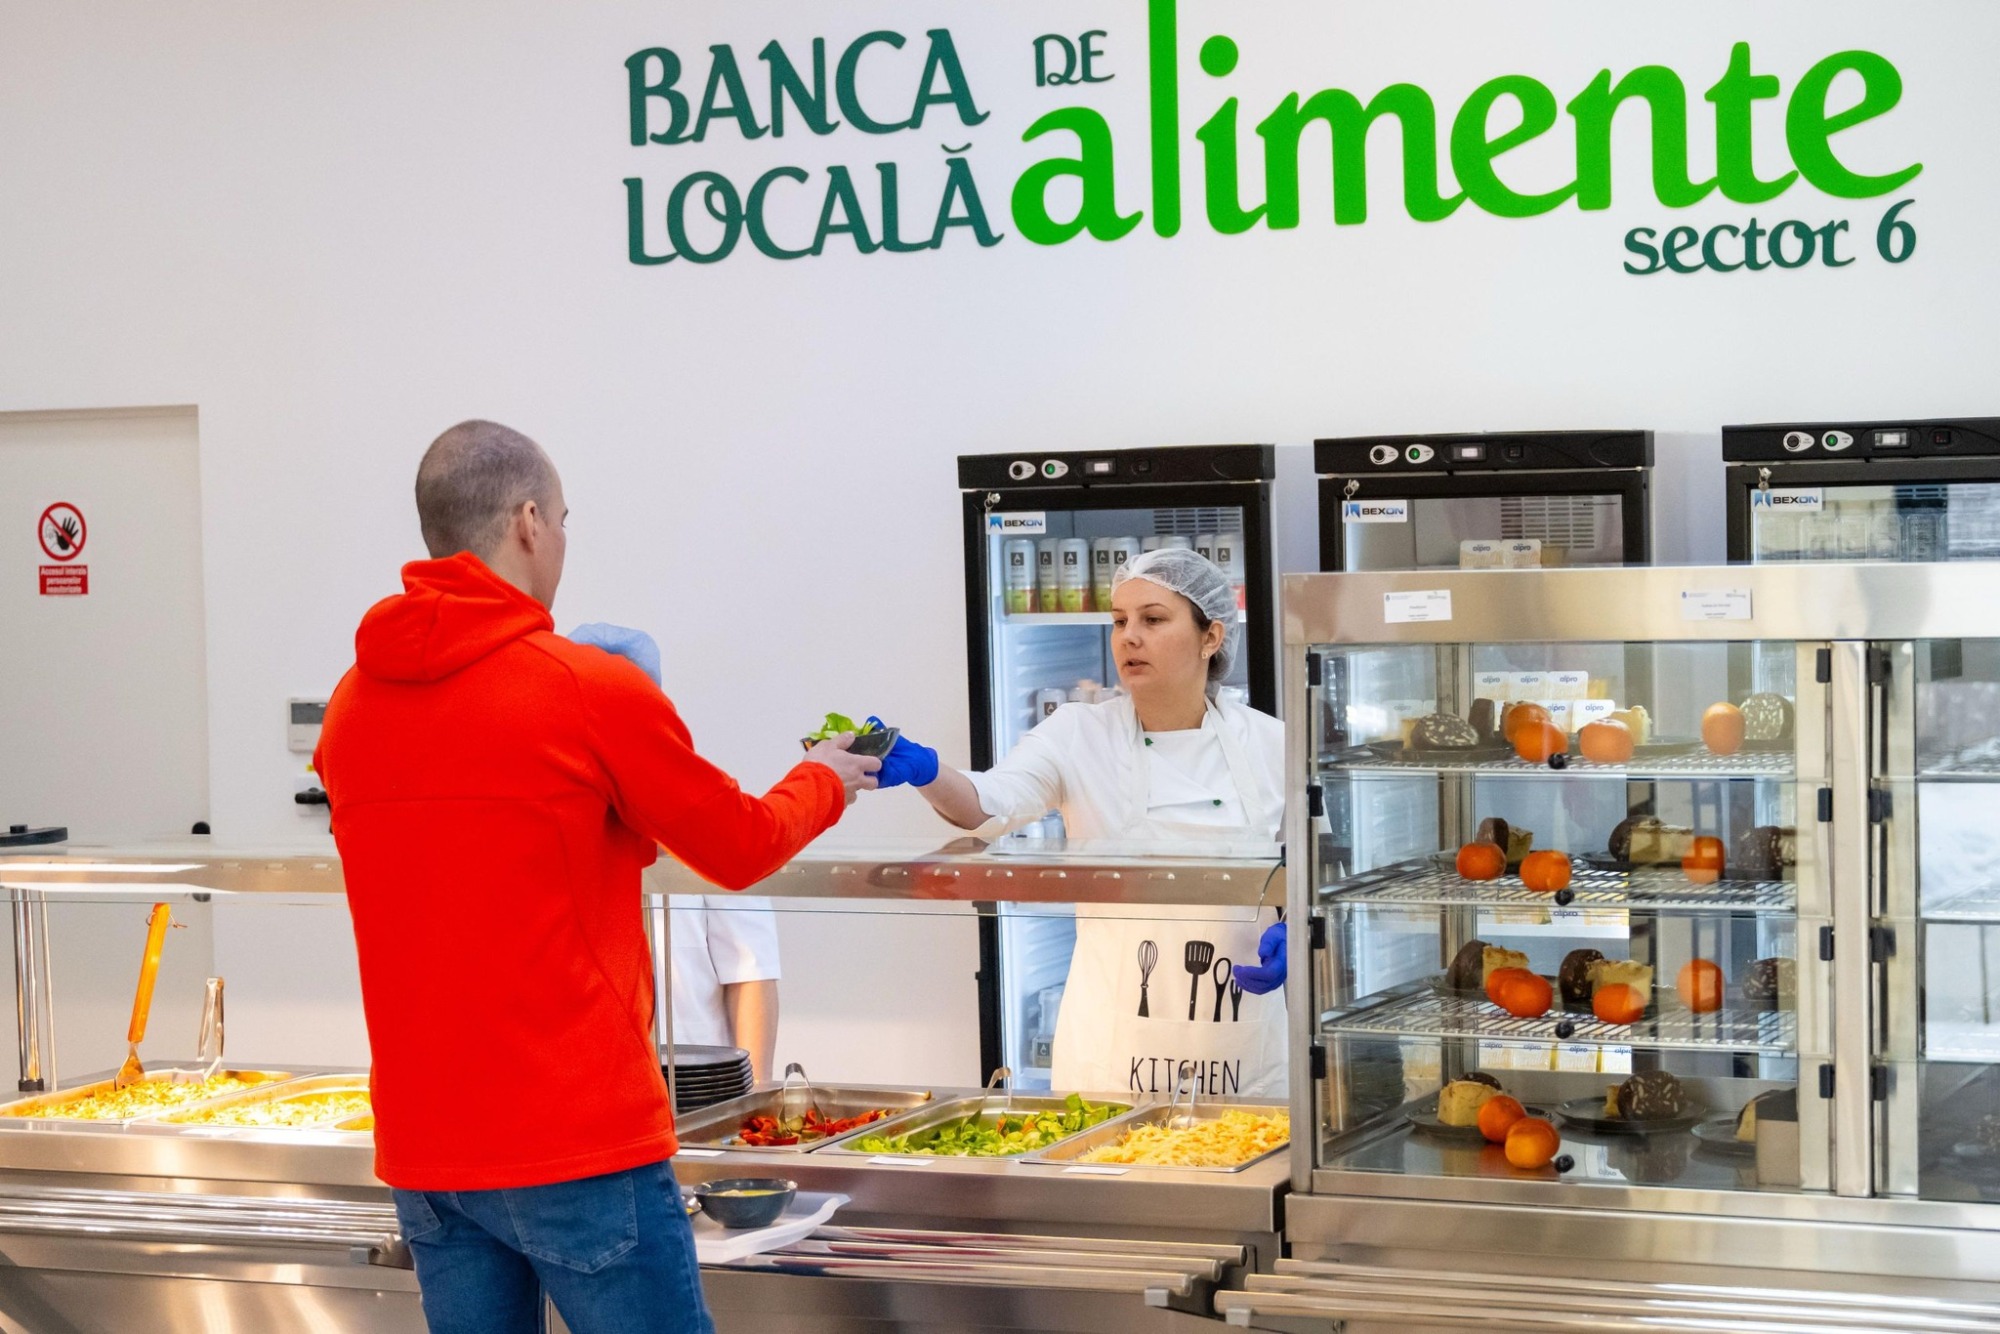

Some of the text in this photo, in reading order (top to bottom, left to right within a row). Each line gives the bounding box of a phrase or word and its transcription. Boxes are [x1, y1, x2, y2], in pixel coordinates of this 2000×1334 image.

[624, 28, 990, 147] BANCA
[1033, 29, 1115, 87] DE
[1011, 0, 1923, 245] alimente
[622, 142, 1004, 266] LOCALĂ
[1624, 199, 1917, 275] sector 6
[1004, 519, 1042, 527] BEXON
[1773, 496, 1818, 504] BEXON
